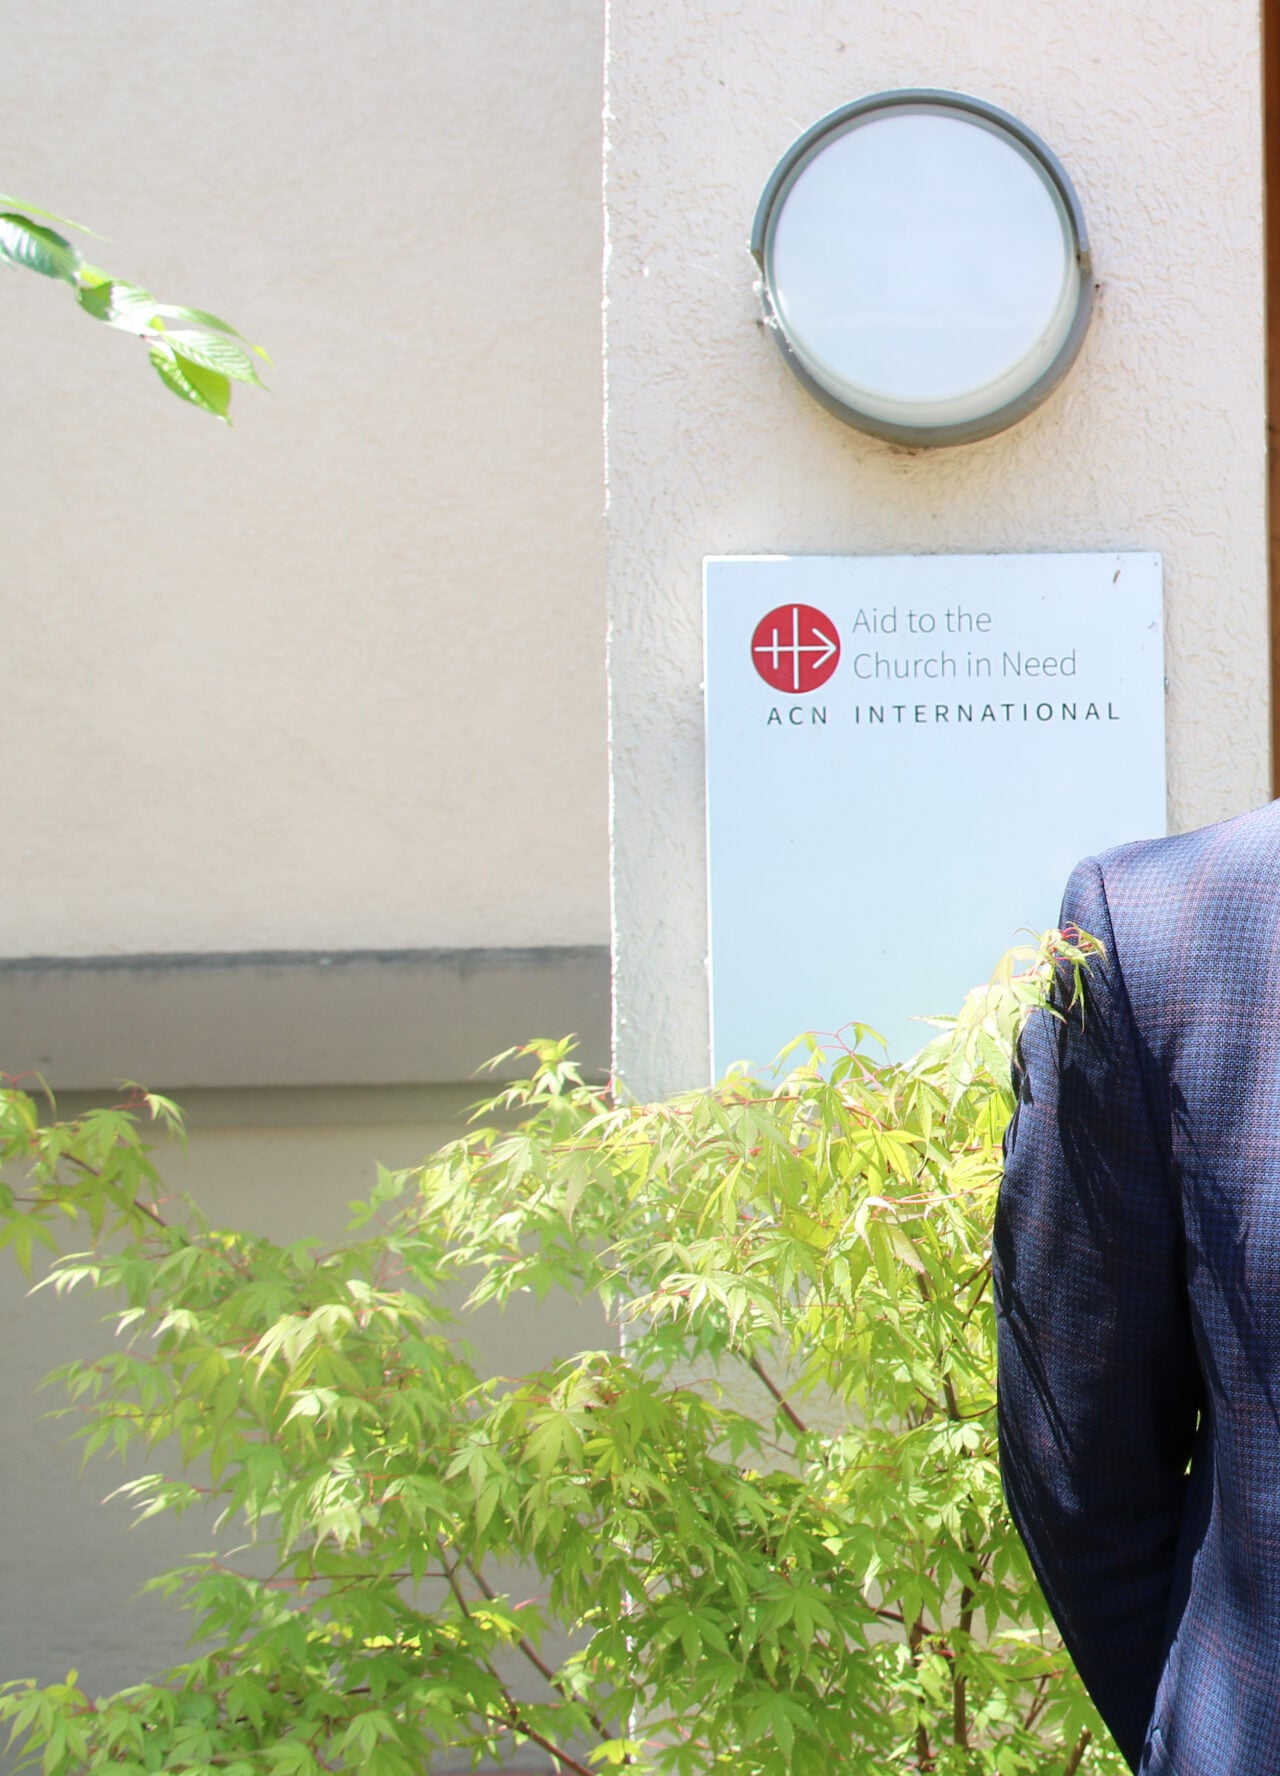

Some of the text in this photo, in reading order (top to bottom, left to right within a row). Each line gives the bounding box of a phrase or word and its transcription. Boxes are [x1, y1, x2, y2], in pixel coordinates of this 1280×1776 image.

[851, 604, 992, 634] Aid to the
[853, 648, 1076, 680] Church in Need
[766, 701, 1121, 726] ACN INTERNATIONAL
